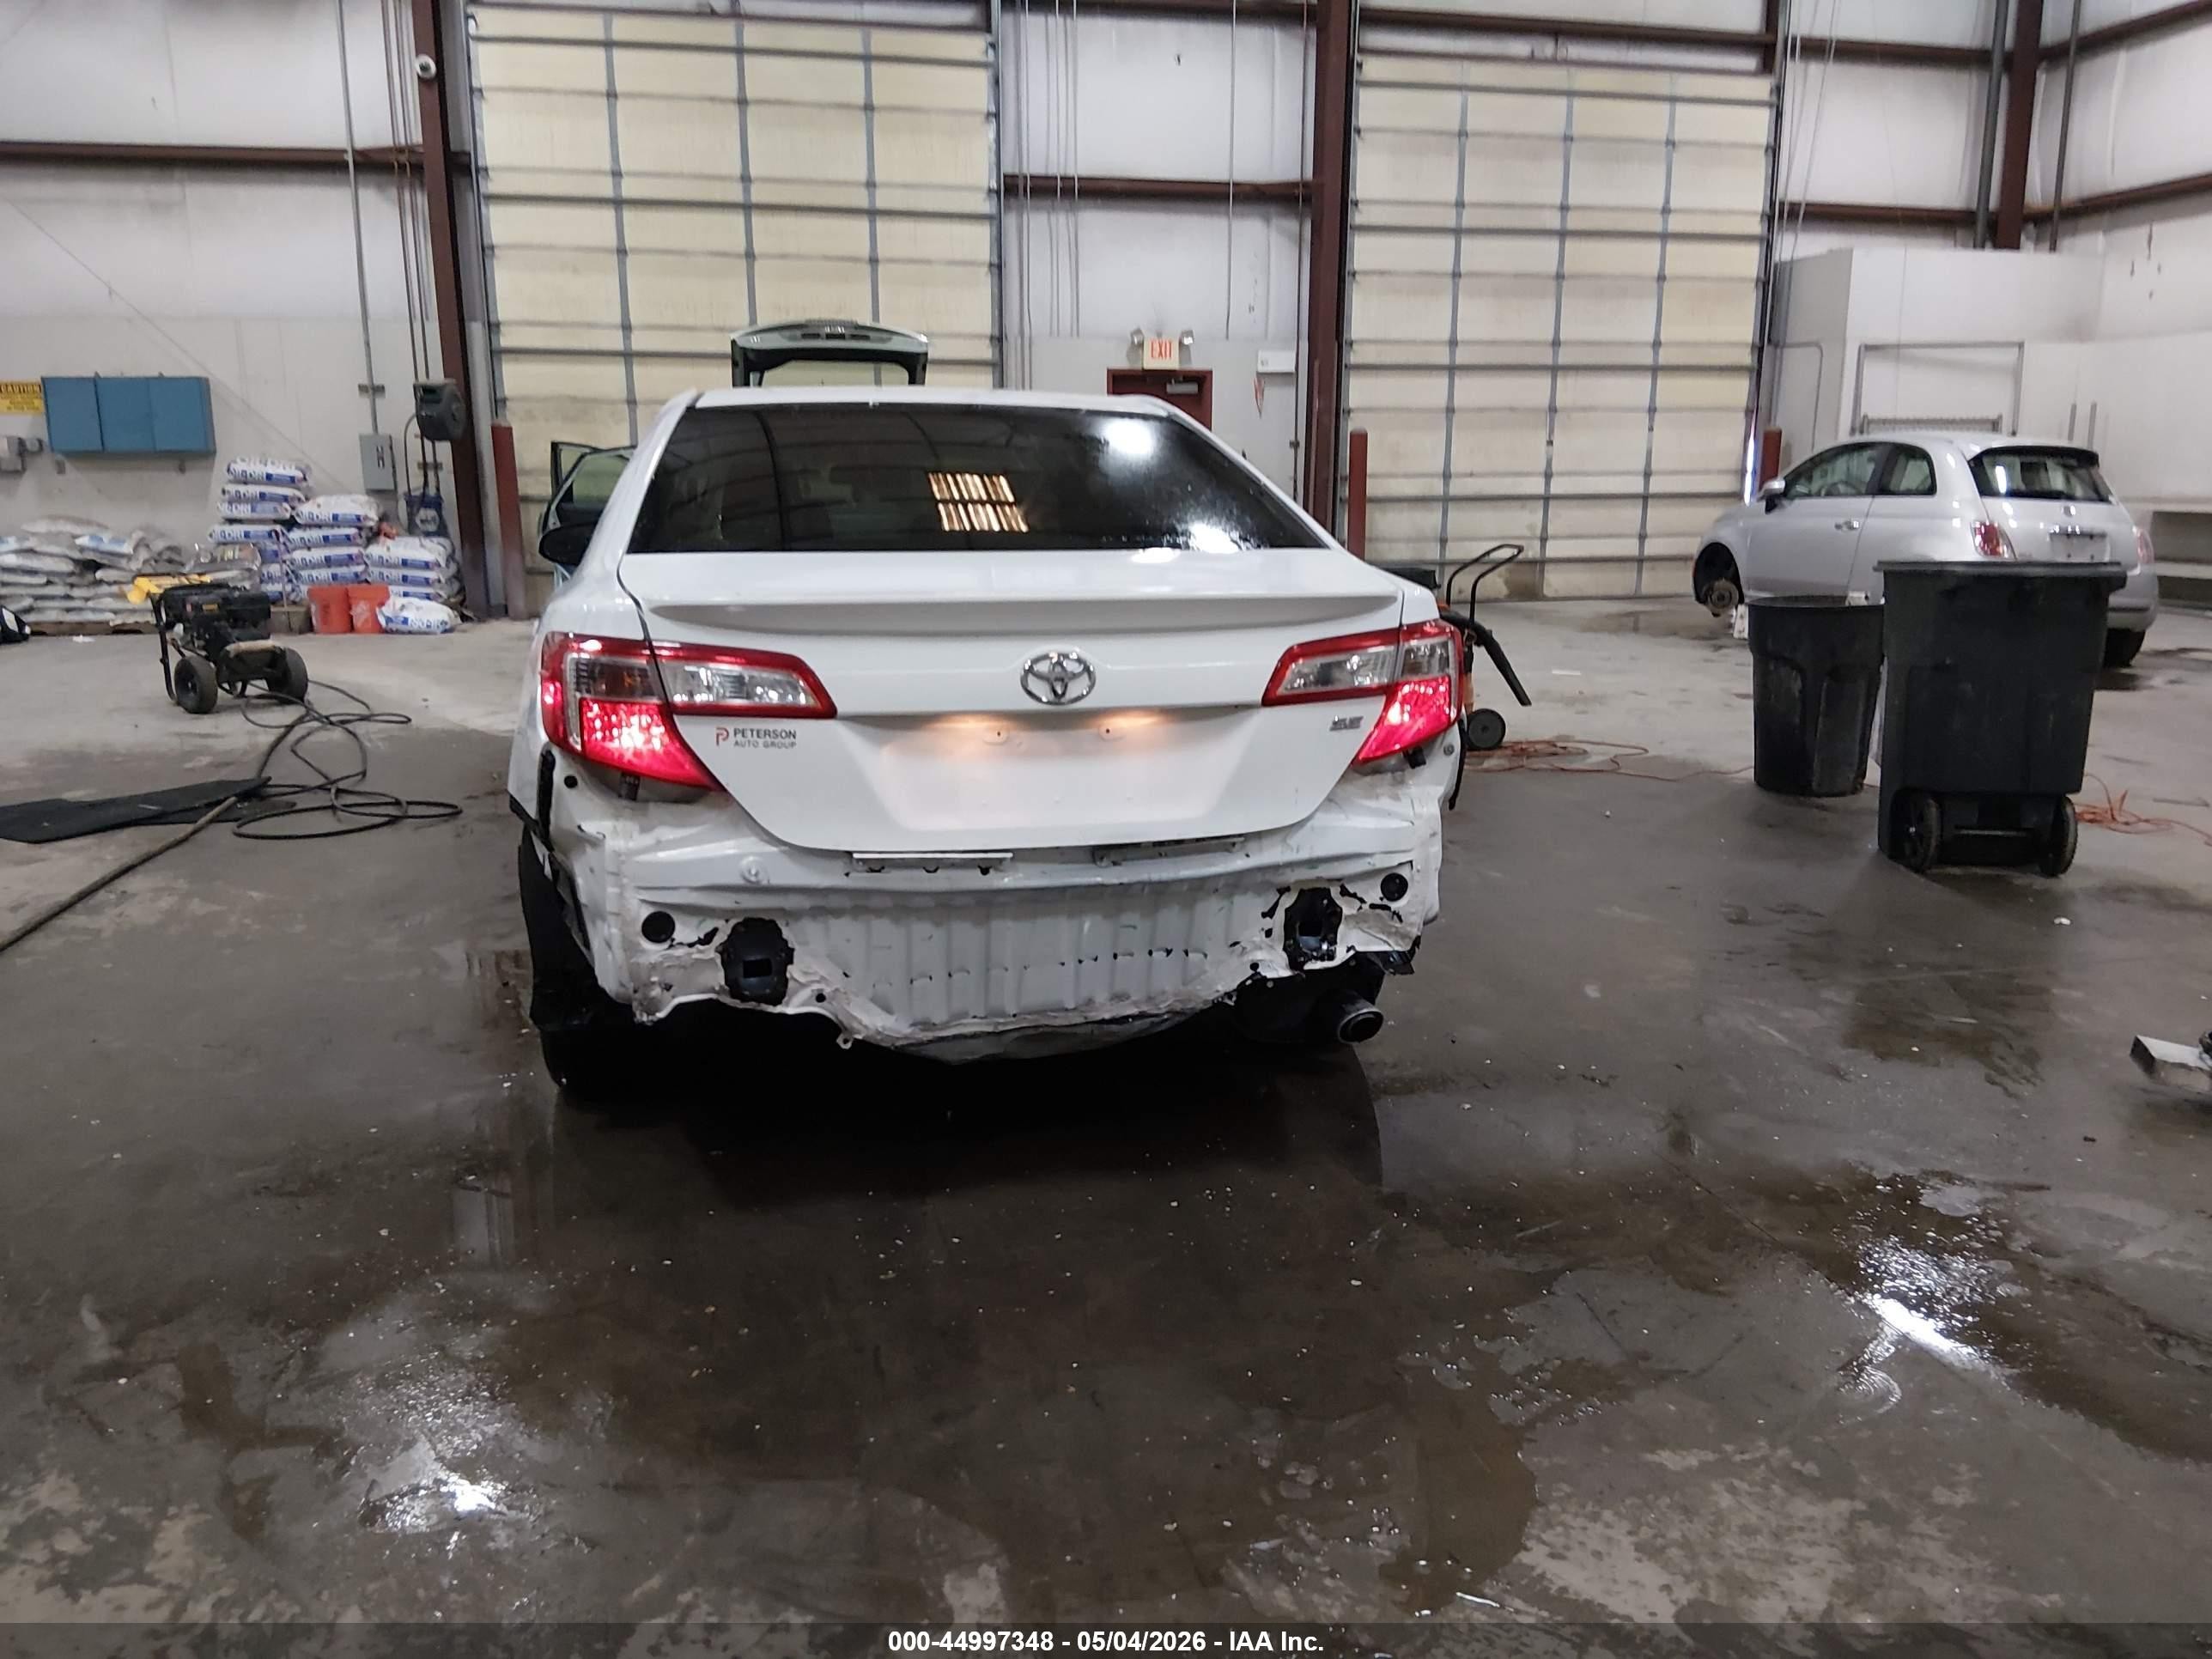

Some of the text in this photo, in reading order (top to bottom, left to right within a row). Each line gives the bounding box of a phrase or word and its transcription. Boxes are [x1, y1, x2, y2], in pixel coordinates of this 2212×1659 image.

[1151, 340, 1172, 360] EXIT
[733, 727, 797, 739] PETERSON
[733, 739, 797, 750] AUTO GROUP
